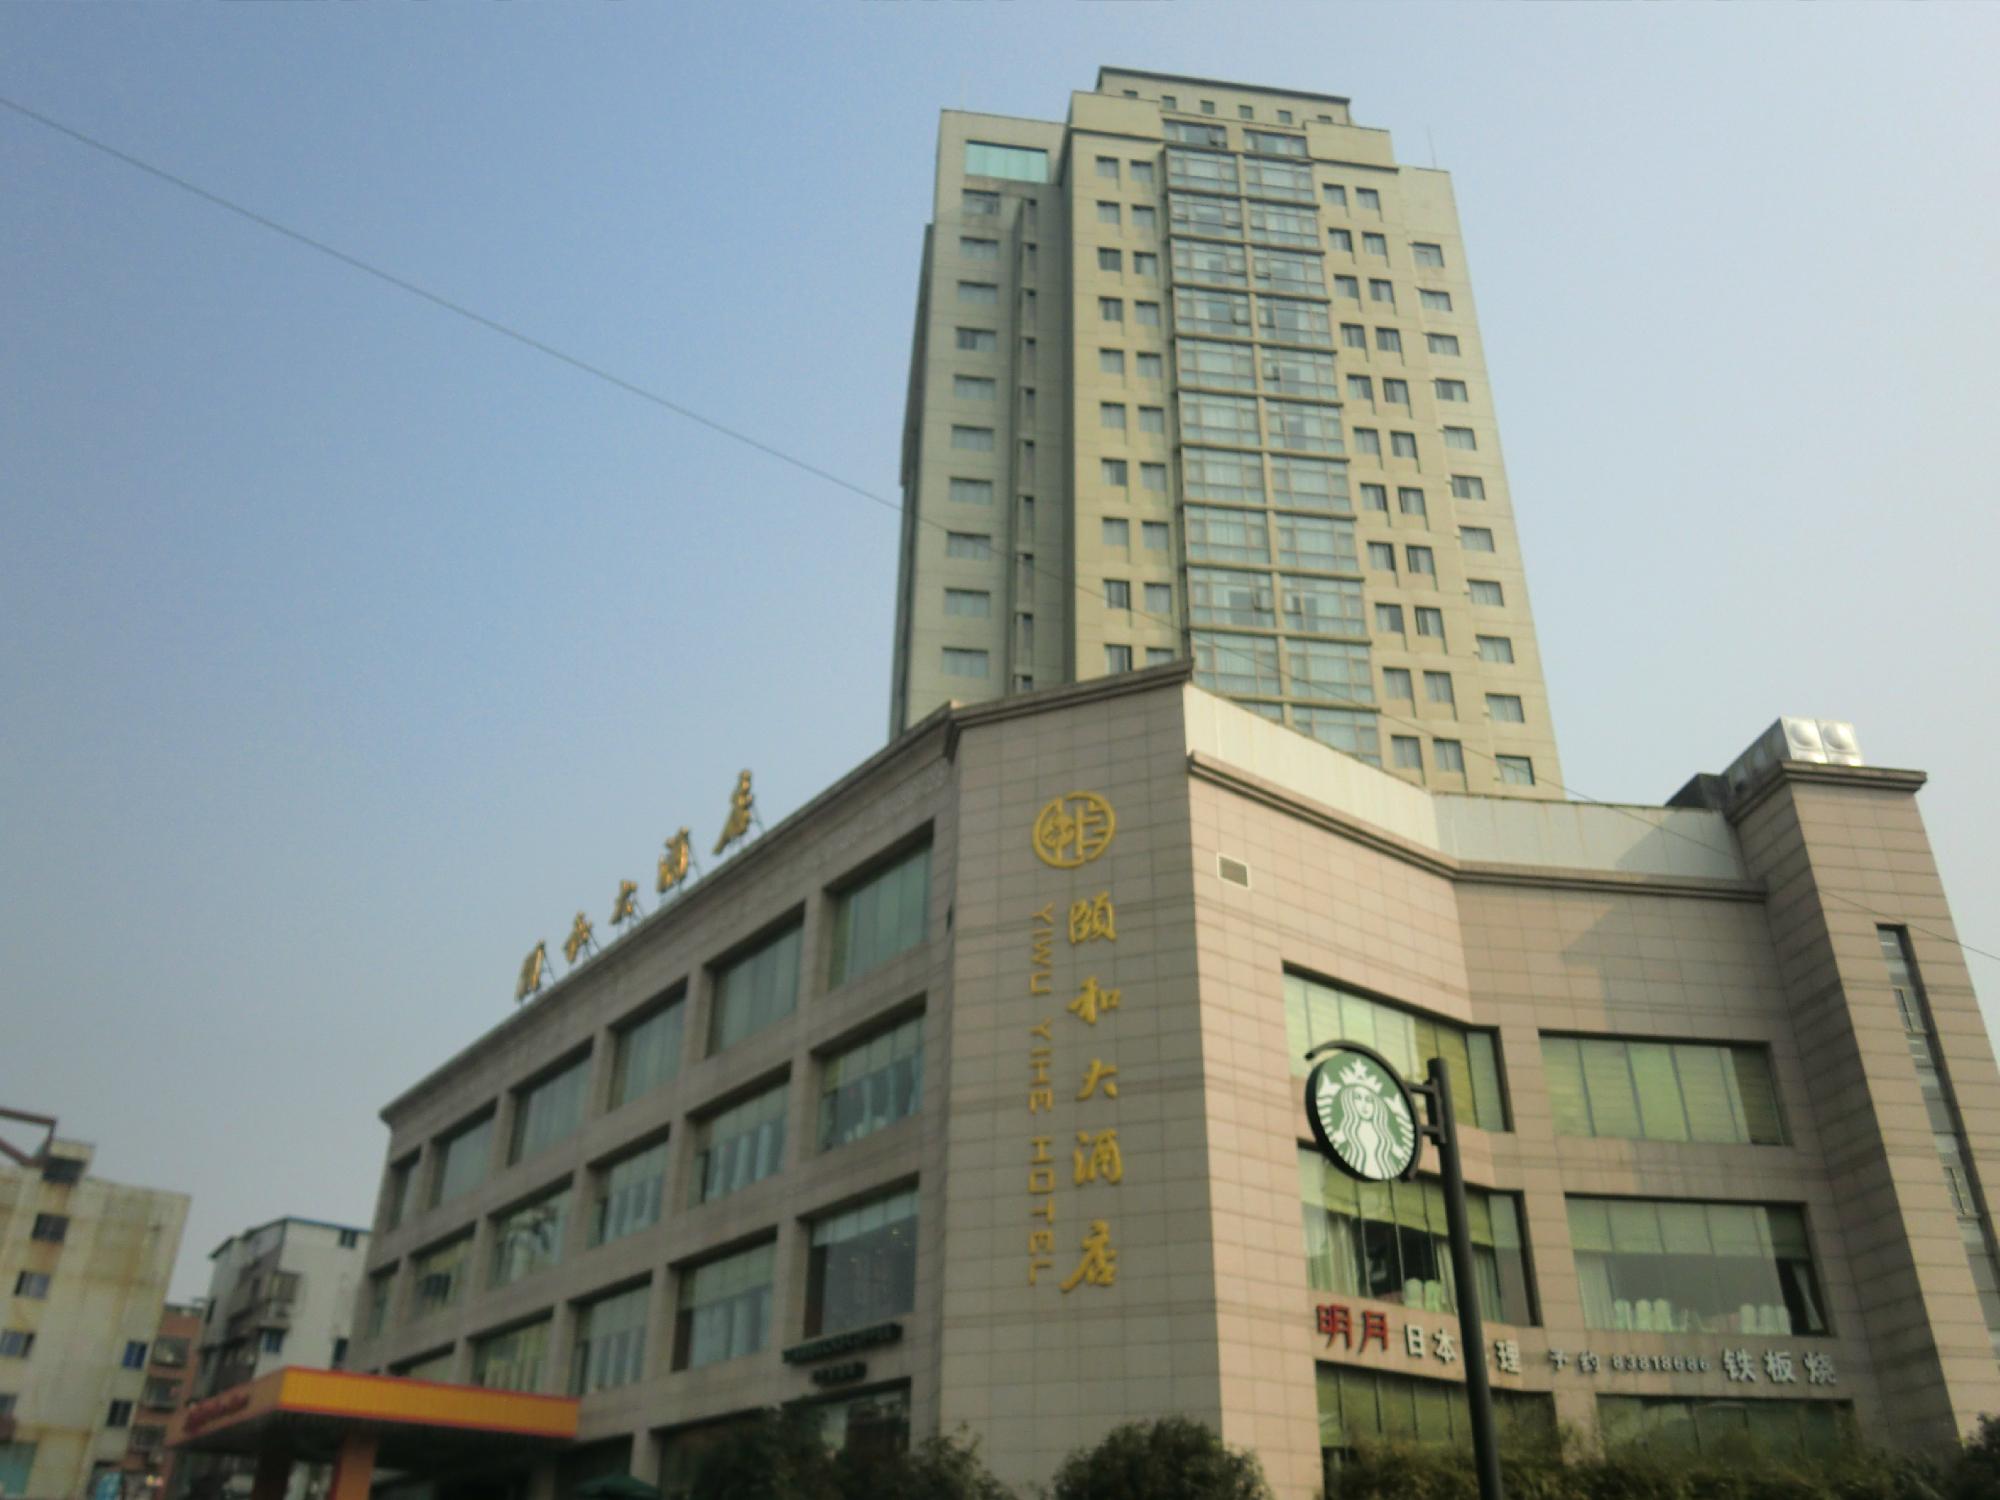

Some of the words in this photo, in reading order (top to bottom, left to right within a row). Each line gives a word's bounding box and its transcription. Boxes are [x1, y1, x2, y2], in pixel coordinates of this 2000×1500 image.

[1030, 900, 1057, 996] YIWU
[1027, 1016, 1056, 1116] YIHE
[1027, 1135, 1058, 1288] HOTEL
[1316, 1303, 1389, 1354] 明月
[1404, 1324, 1521, 1375] 日本理
[1722, 1347, 1838, 1385] 铁板烧
